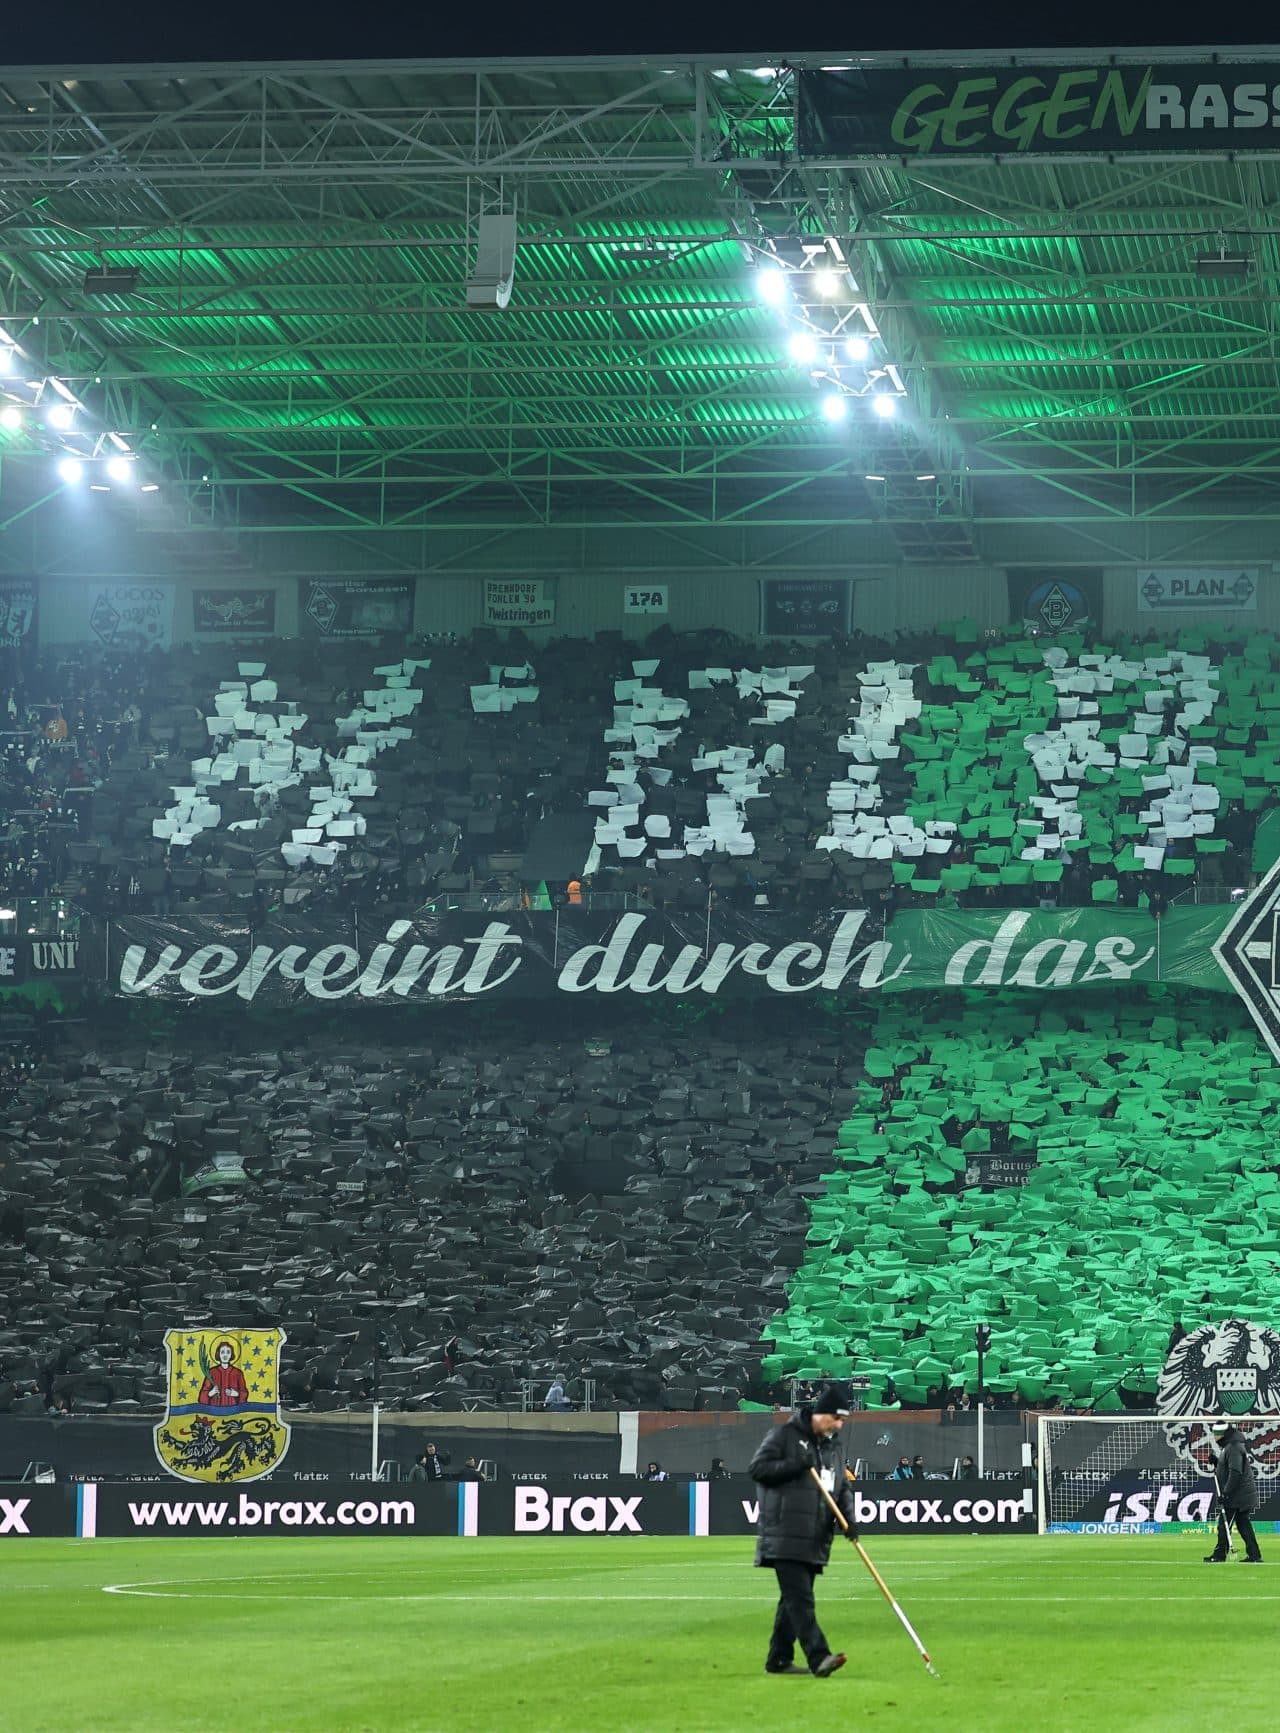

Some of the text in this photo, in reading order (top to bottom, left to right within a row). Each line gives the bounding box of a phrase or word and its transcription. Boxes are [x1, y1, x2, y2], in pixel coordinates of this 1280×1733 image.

[890, 66, 1152, 152] GEGEN
[629, 592, 663, 607] 17A
[1170, 579, 1225, 597] PLAN
[488, 607, 551, 624] Twistringen
[119, 912, 1156, 1000] vereint durch das
[293, 1471, 329, 1481] flatex
[129, 1492, 417, 1526] www.brax.com
[515, 1486, 643, 1533] Brax
[1103, 1484, 1213, 1522] ista
